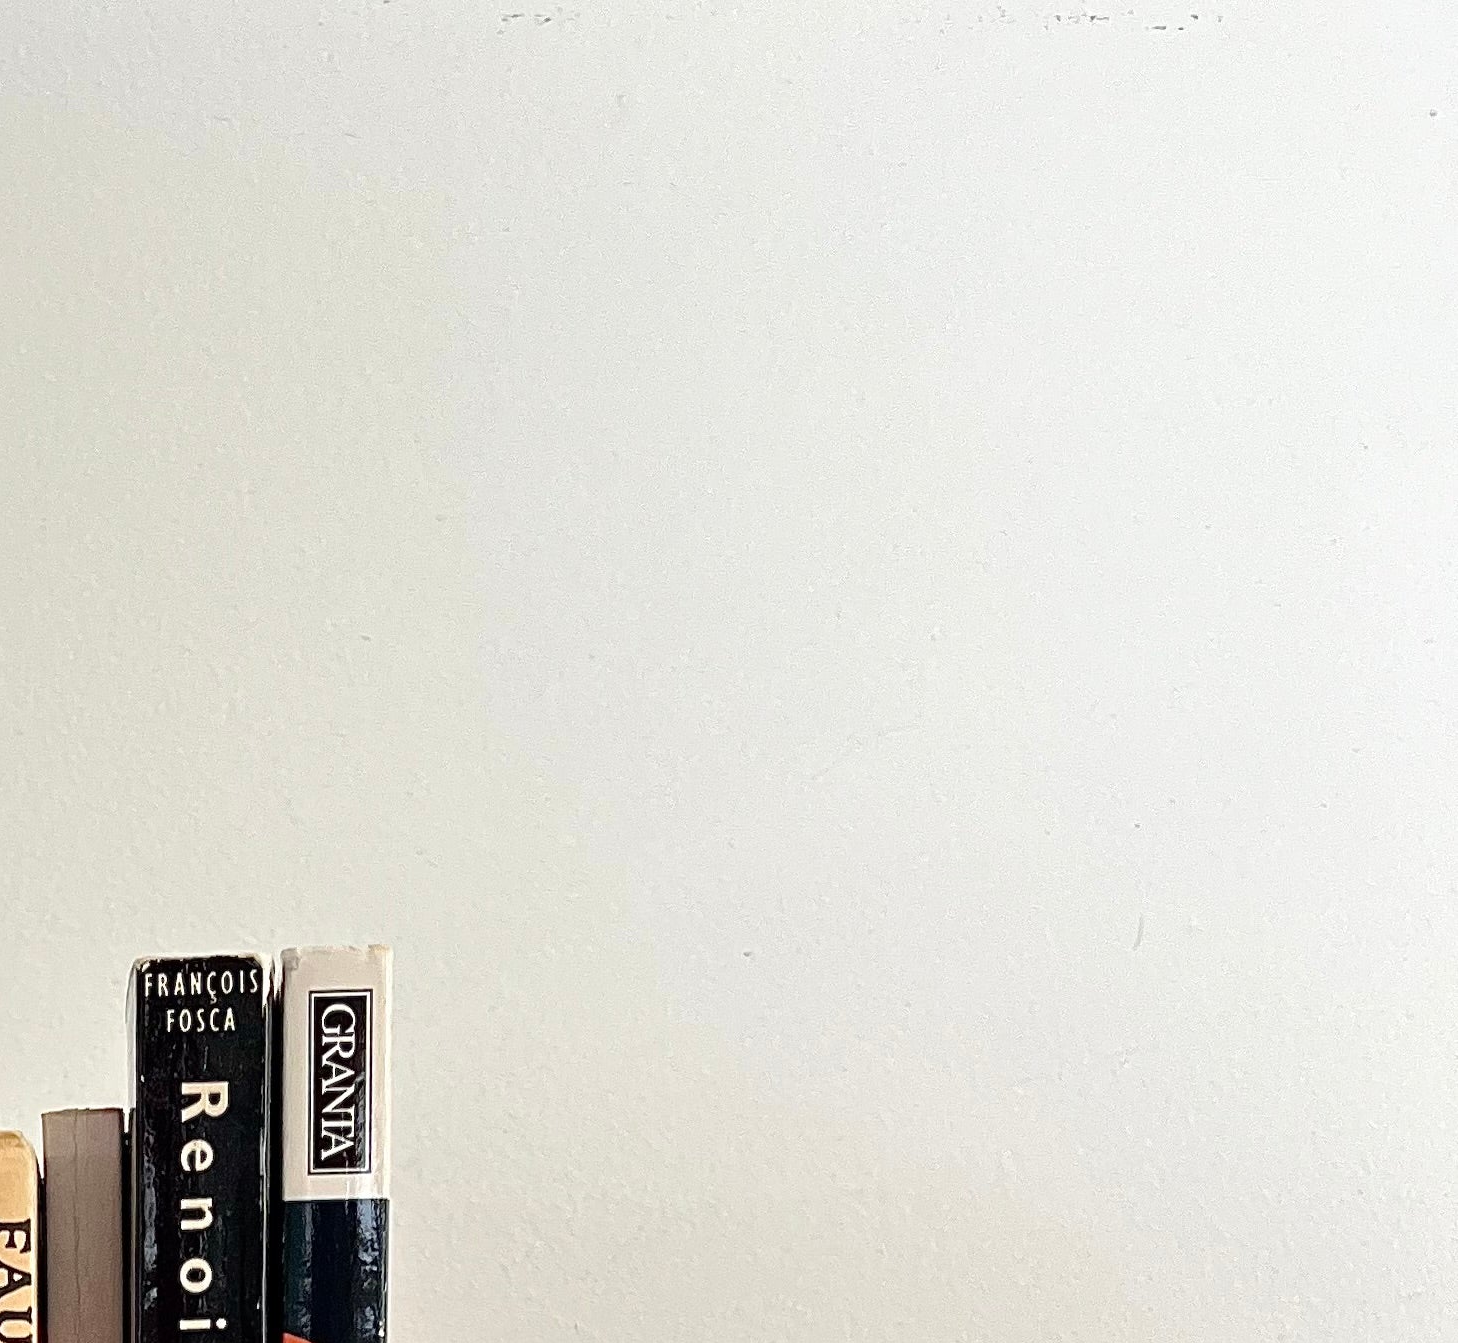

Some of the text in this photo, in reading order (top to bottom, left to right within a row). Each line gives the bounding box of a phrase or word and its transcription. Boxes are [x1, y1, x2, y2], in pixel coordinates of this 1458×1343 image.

[144, 969, 258, 1004] FRANÇOIS
[166, 1007, 236, 1033] FOSCA
[321, 1003, 356, 1161] GRANTA
